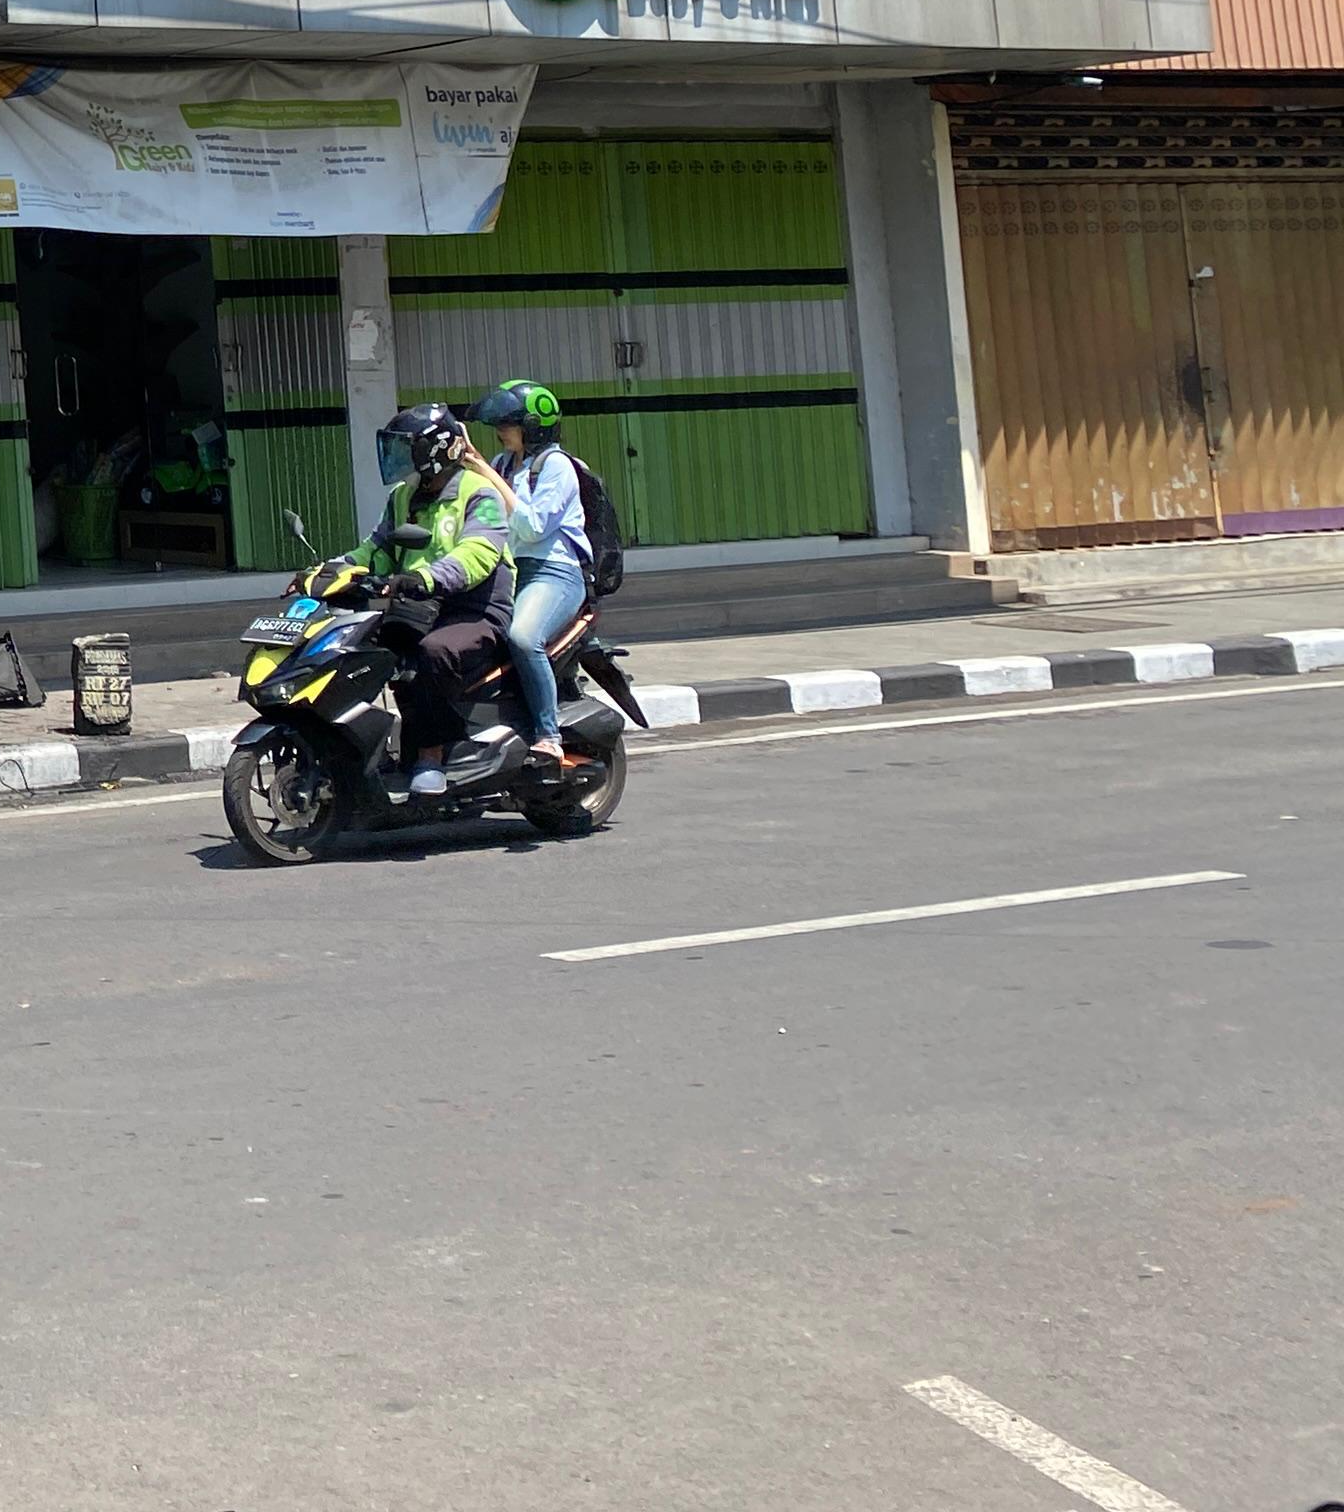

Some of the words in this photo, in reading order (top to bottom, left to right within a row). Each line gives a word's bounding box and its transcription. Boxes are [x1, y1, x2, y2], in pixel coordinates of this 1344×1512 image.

[425, 85, 471, 106] bayar
[475, 85, 518, 107] pakai
[118, 145, 193, 172] Green
[109, 676, 131, 690] 27
